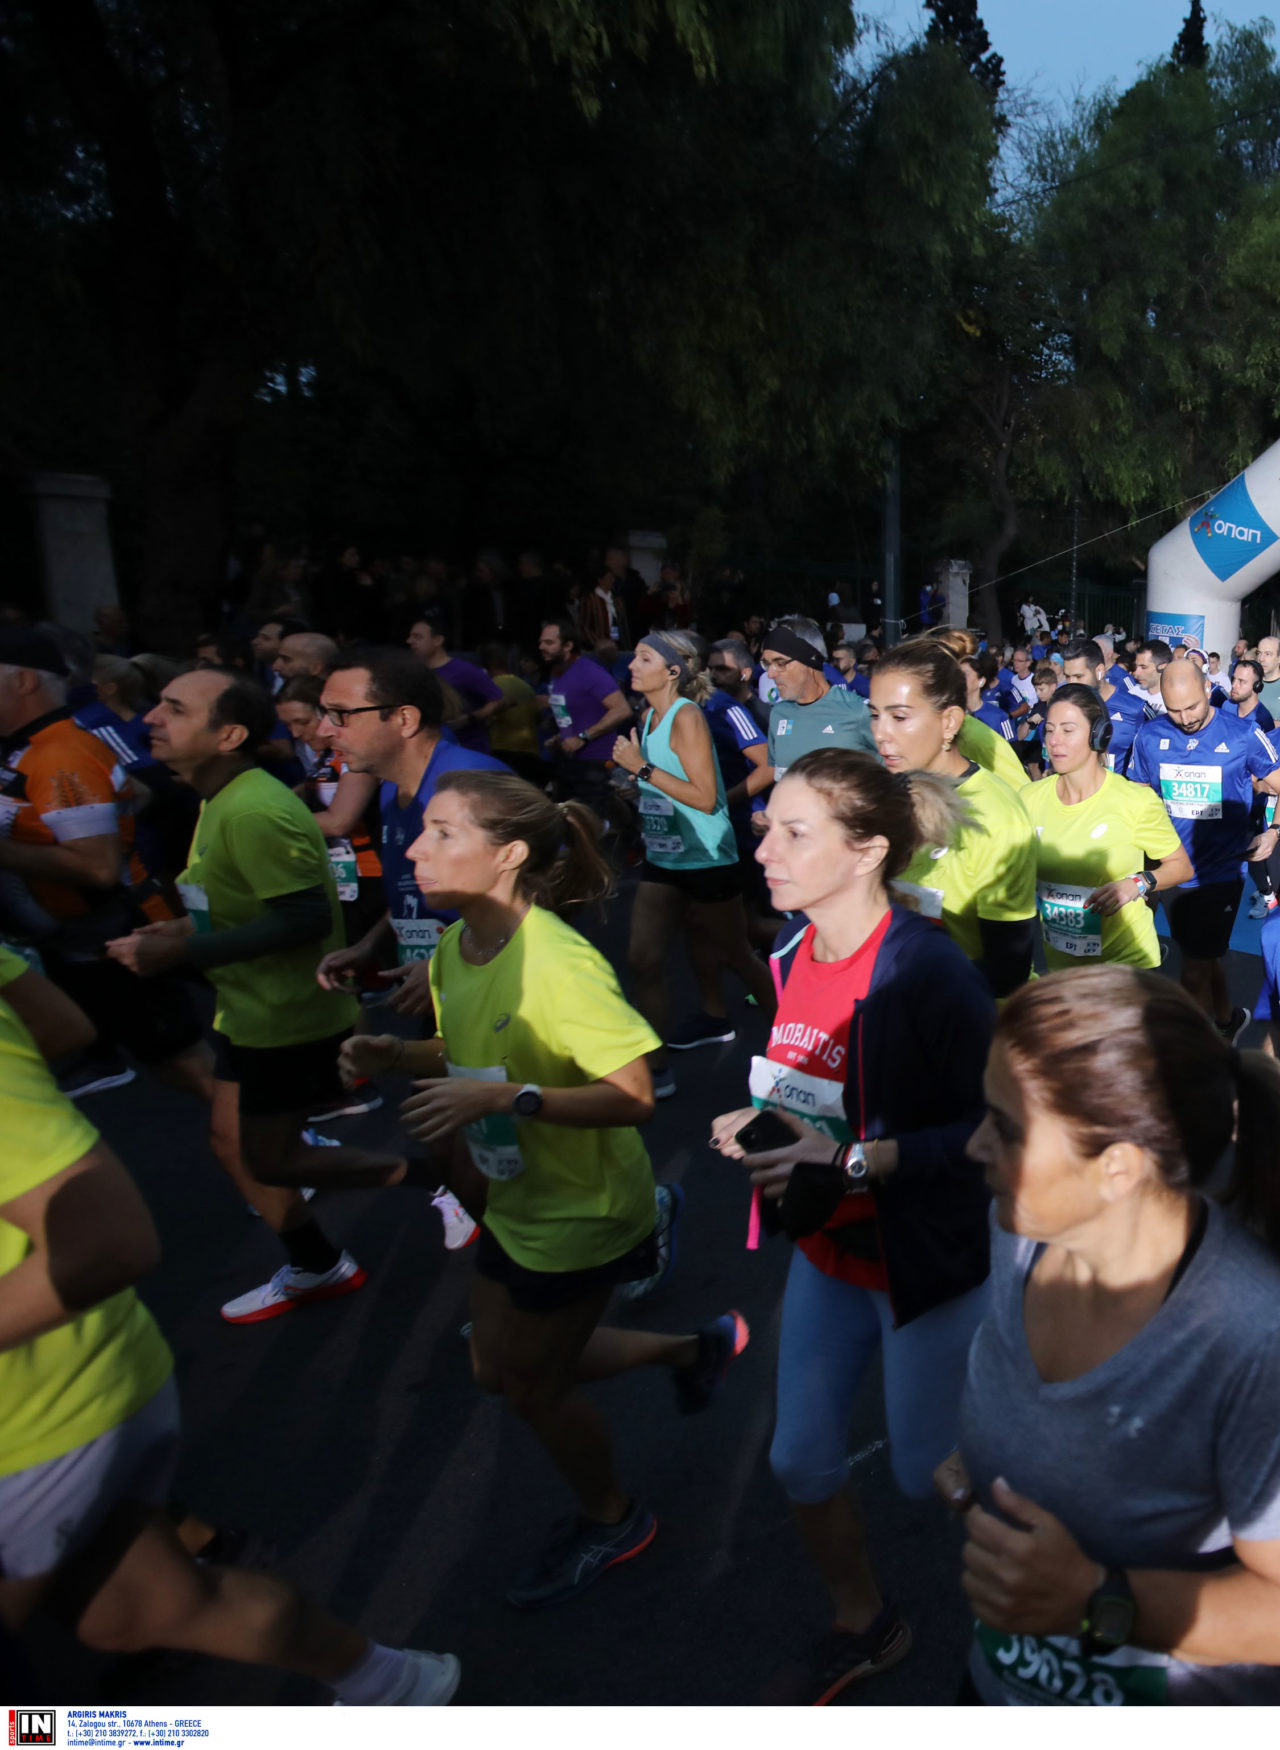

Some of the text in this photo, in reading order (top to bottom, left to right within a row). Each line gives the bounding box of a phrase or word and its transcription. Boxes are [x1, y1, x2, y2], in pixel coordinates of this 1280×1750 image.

[1214, 520, 1261, 543] οπαπ
[1149, 623, 1185, 635] ΣΕΓΑΣ
[1171, 782, 1210, 798] 34817
[1044, 903, 1085, 928] 34383
[771, 1022, 846, 1068] MORAITIS
